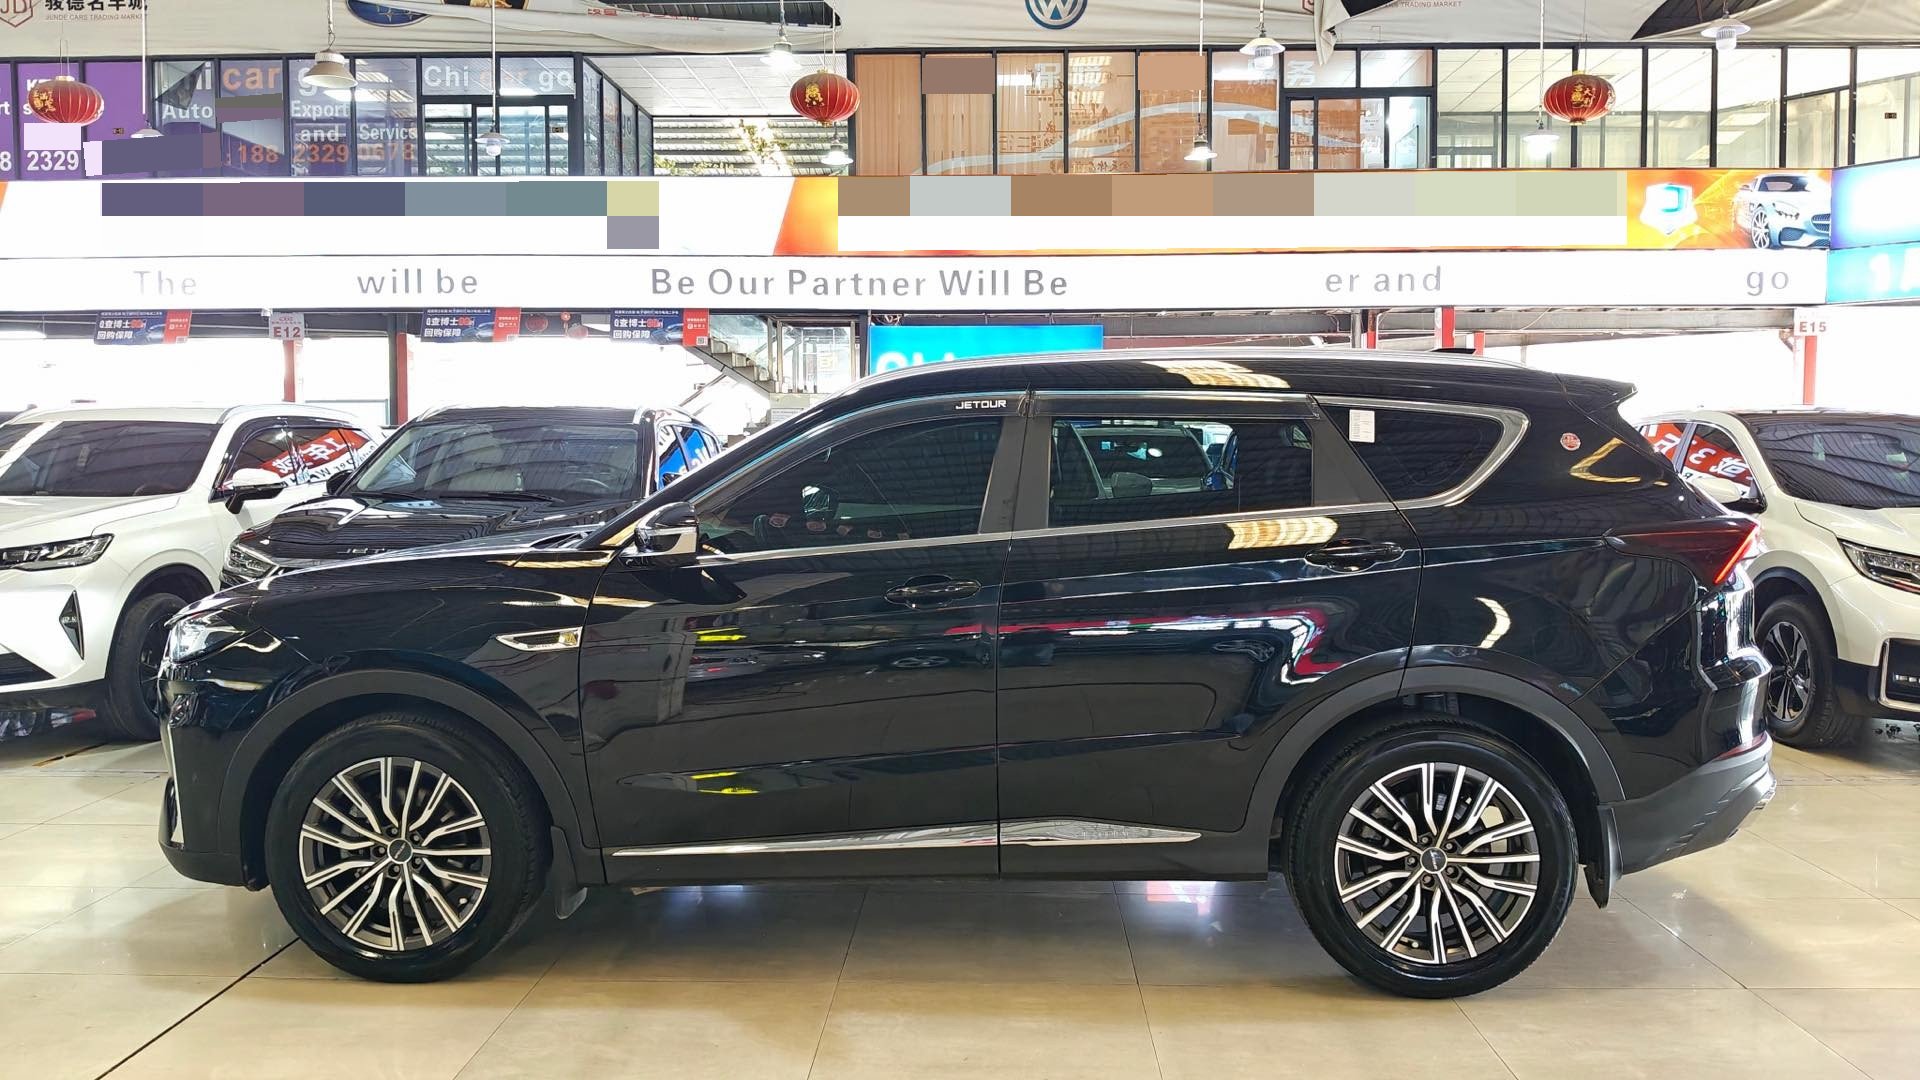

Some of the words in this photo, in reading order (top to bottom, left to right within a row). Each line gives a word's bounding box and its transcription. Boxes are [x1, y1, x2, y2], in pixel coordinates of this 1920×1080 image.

[223, 66, 281, 91] car
[424, 65, 469, 87] Chi
[538, 70, 573, 93] go
[162, 103, 213, 120] Auto
[291, 100, 350, 121] Export
[299, 126, 340, 142] and
[27, 151, 79, 171] 2329
[238, 144, 279, 163] 188
[293, 143, 350, 163] 2329
[133, 268, 197, 297] The
[357, 265, 423, 297] will
[436, 265, 478, 298] be
[651, 266, 695, 297] Be
[708, 266, 775, 298] Our
[788, 266, 927, 298] Partner
[938, 267, 1010, 298] Will
[1024, 267, 1068, 298] Be
[1373, 263, 1442, 295] and
[1746, 270, 1790, 297] go
[273, 326, 301, 338] E12
[1799, 321, 1826, 333] E15
[955, 399, 1007, 410] JETOUR
